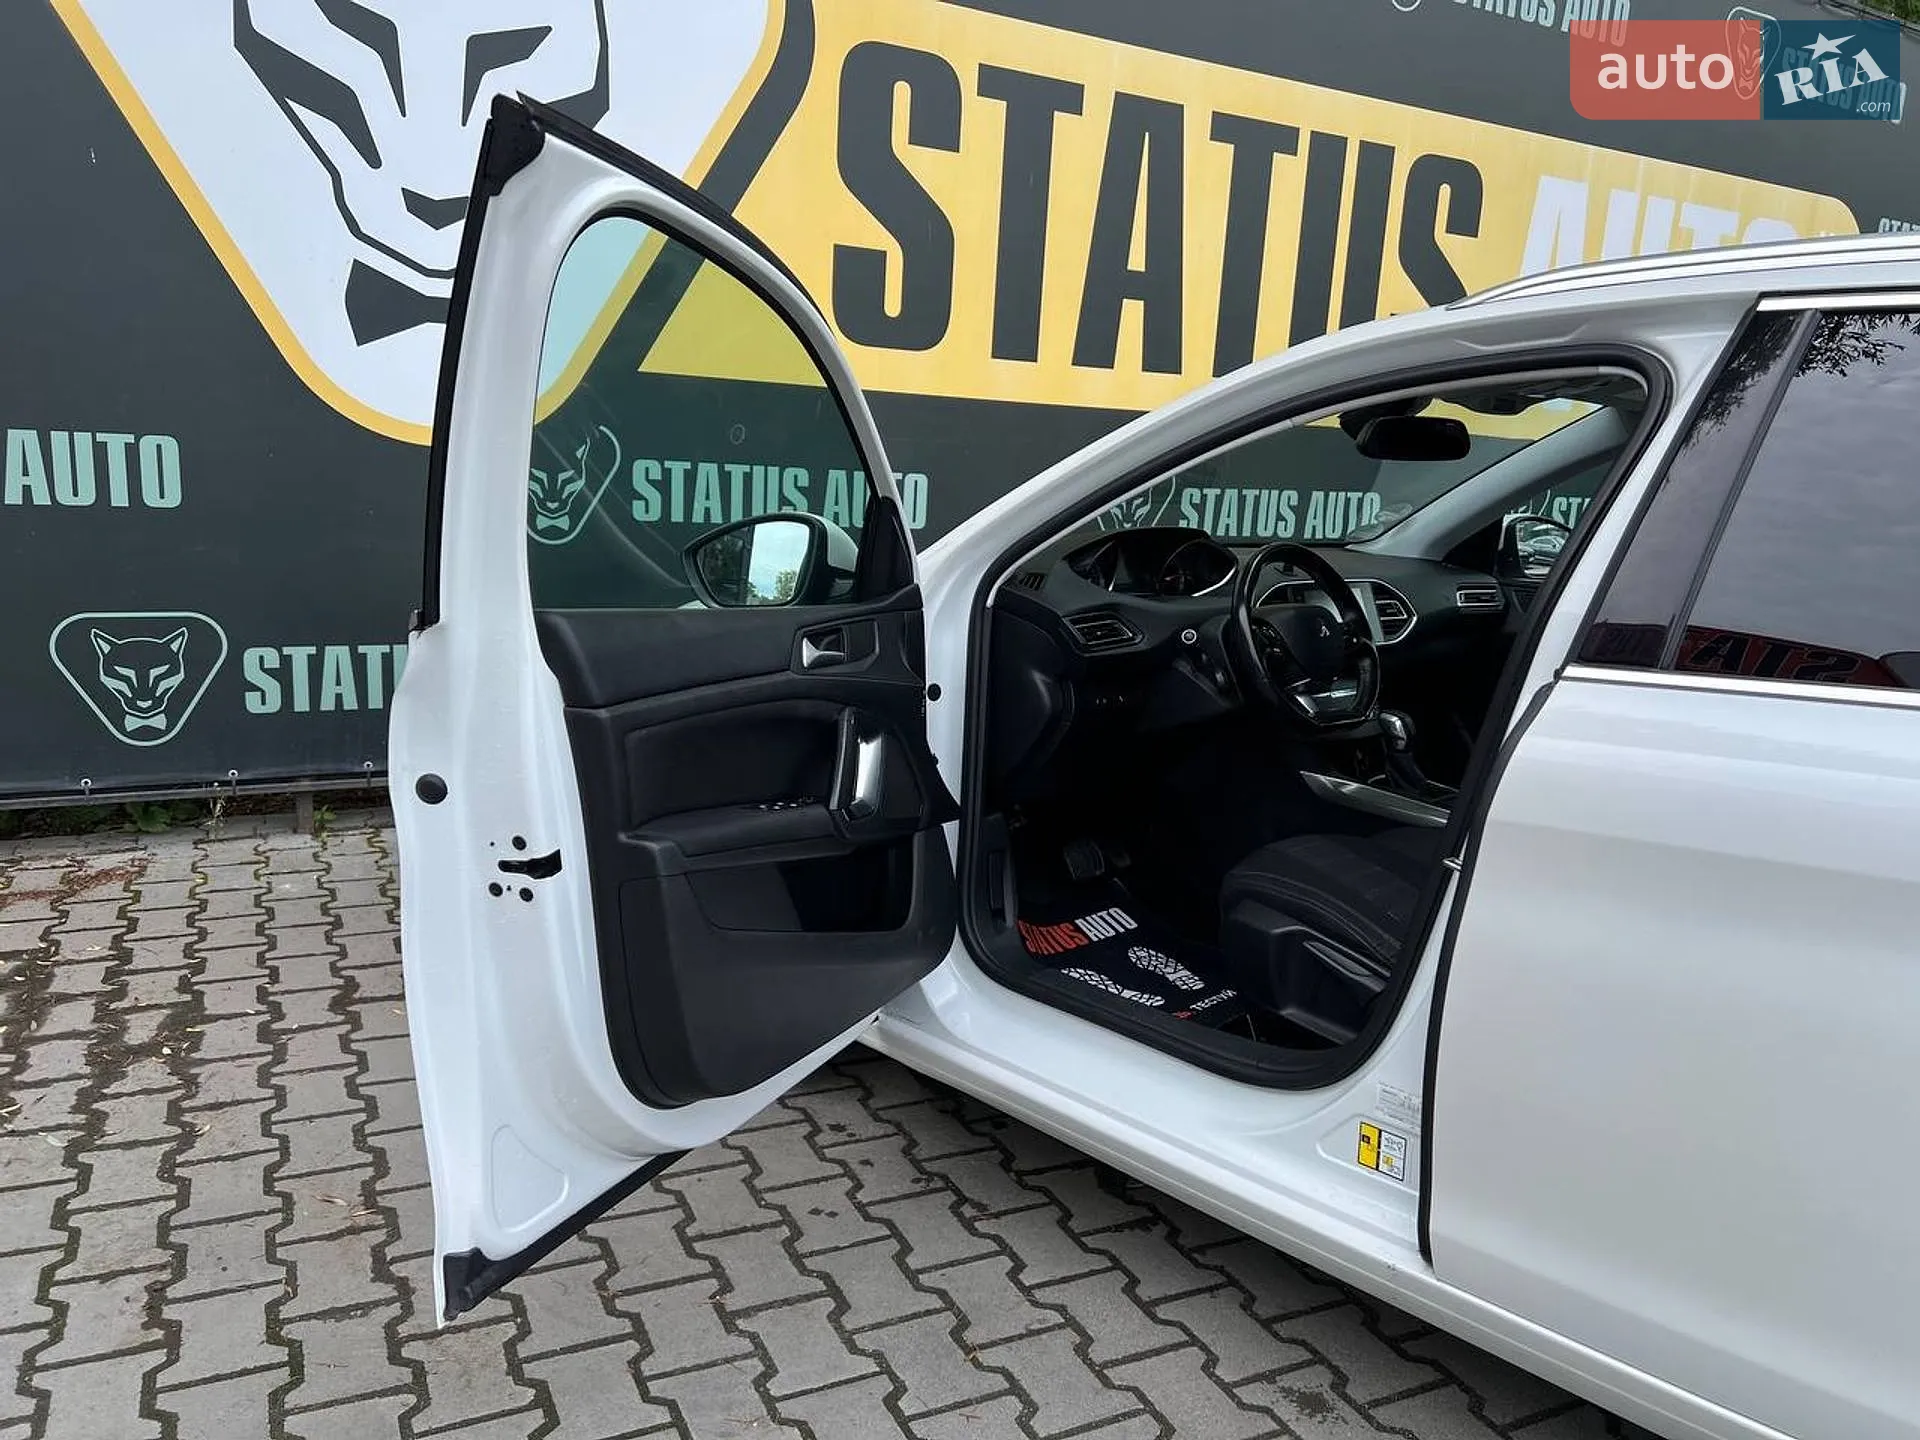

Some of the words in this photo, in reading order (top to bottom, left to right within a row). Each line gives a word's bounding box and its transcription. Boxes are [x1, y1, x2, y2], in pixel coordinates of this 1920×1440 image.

[832, 40, 1484, 378] STATUS
[4, 429, 183, 509] AUTO
[631, 458, 809, 524] STATUS
[1178, 487, 1299, 538] STATUS
[242, 643, 409, 714] STAT
[1075, 907, 1138, 942] AUTO
